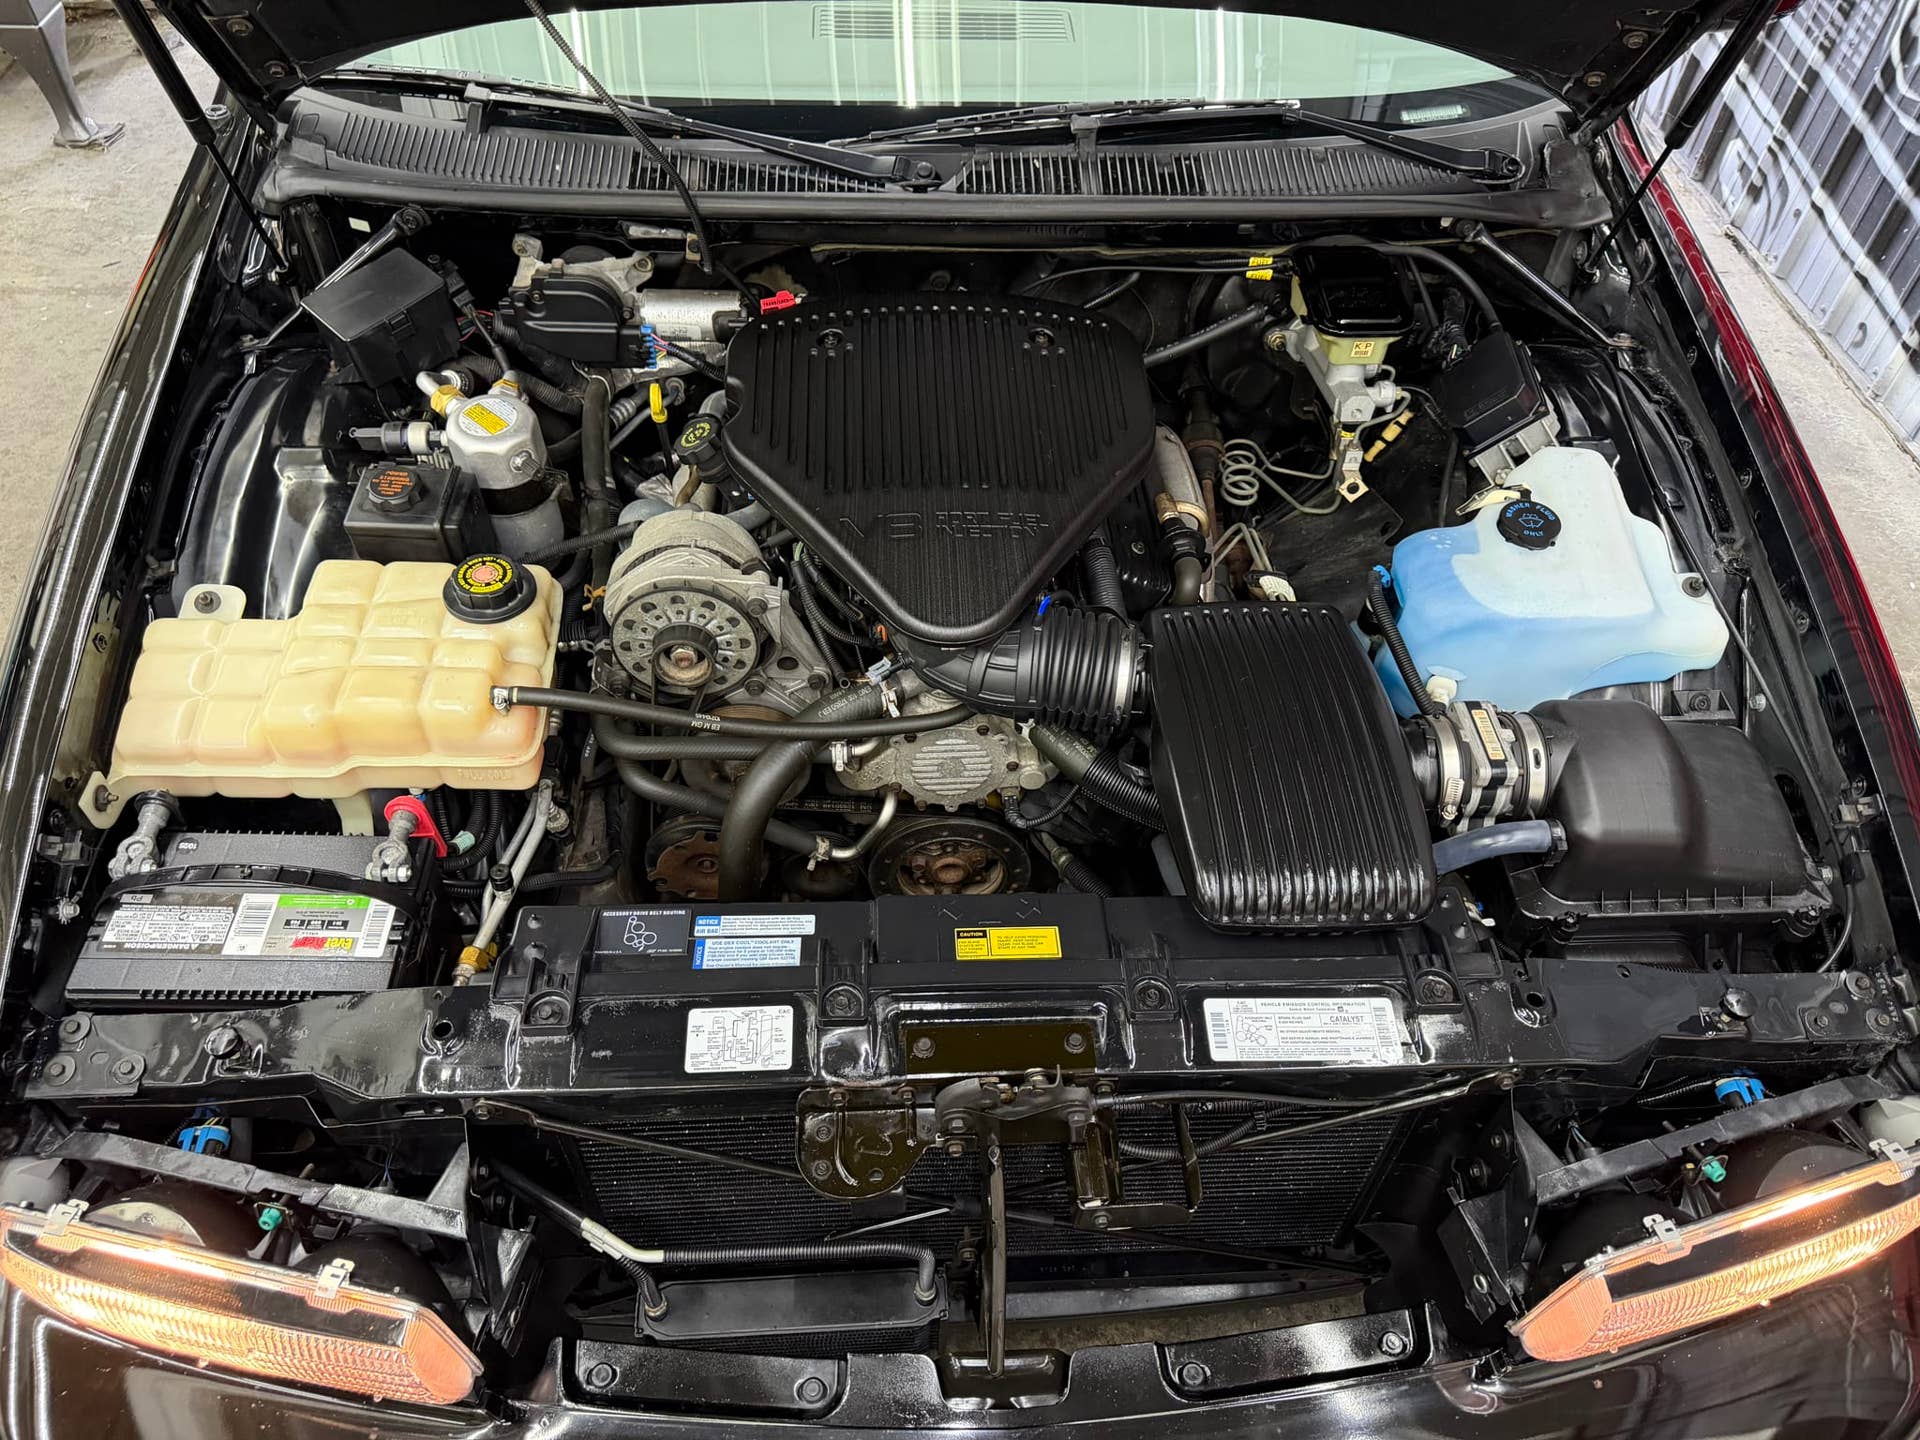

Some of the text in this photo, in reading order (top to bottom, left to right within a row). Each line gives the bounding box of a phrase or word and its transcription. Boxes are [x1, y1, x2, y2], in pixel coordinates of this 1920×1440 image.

[1505, 502, 1556, 520] WASHER FLUID
[1523, 529, 1544, 537] ONLY
[695, 946, 703, 965] NOTICE
